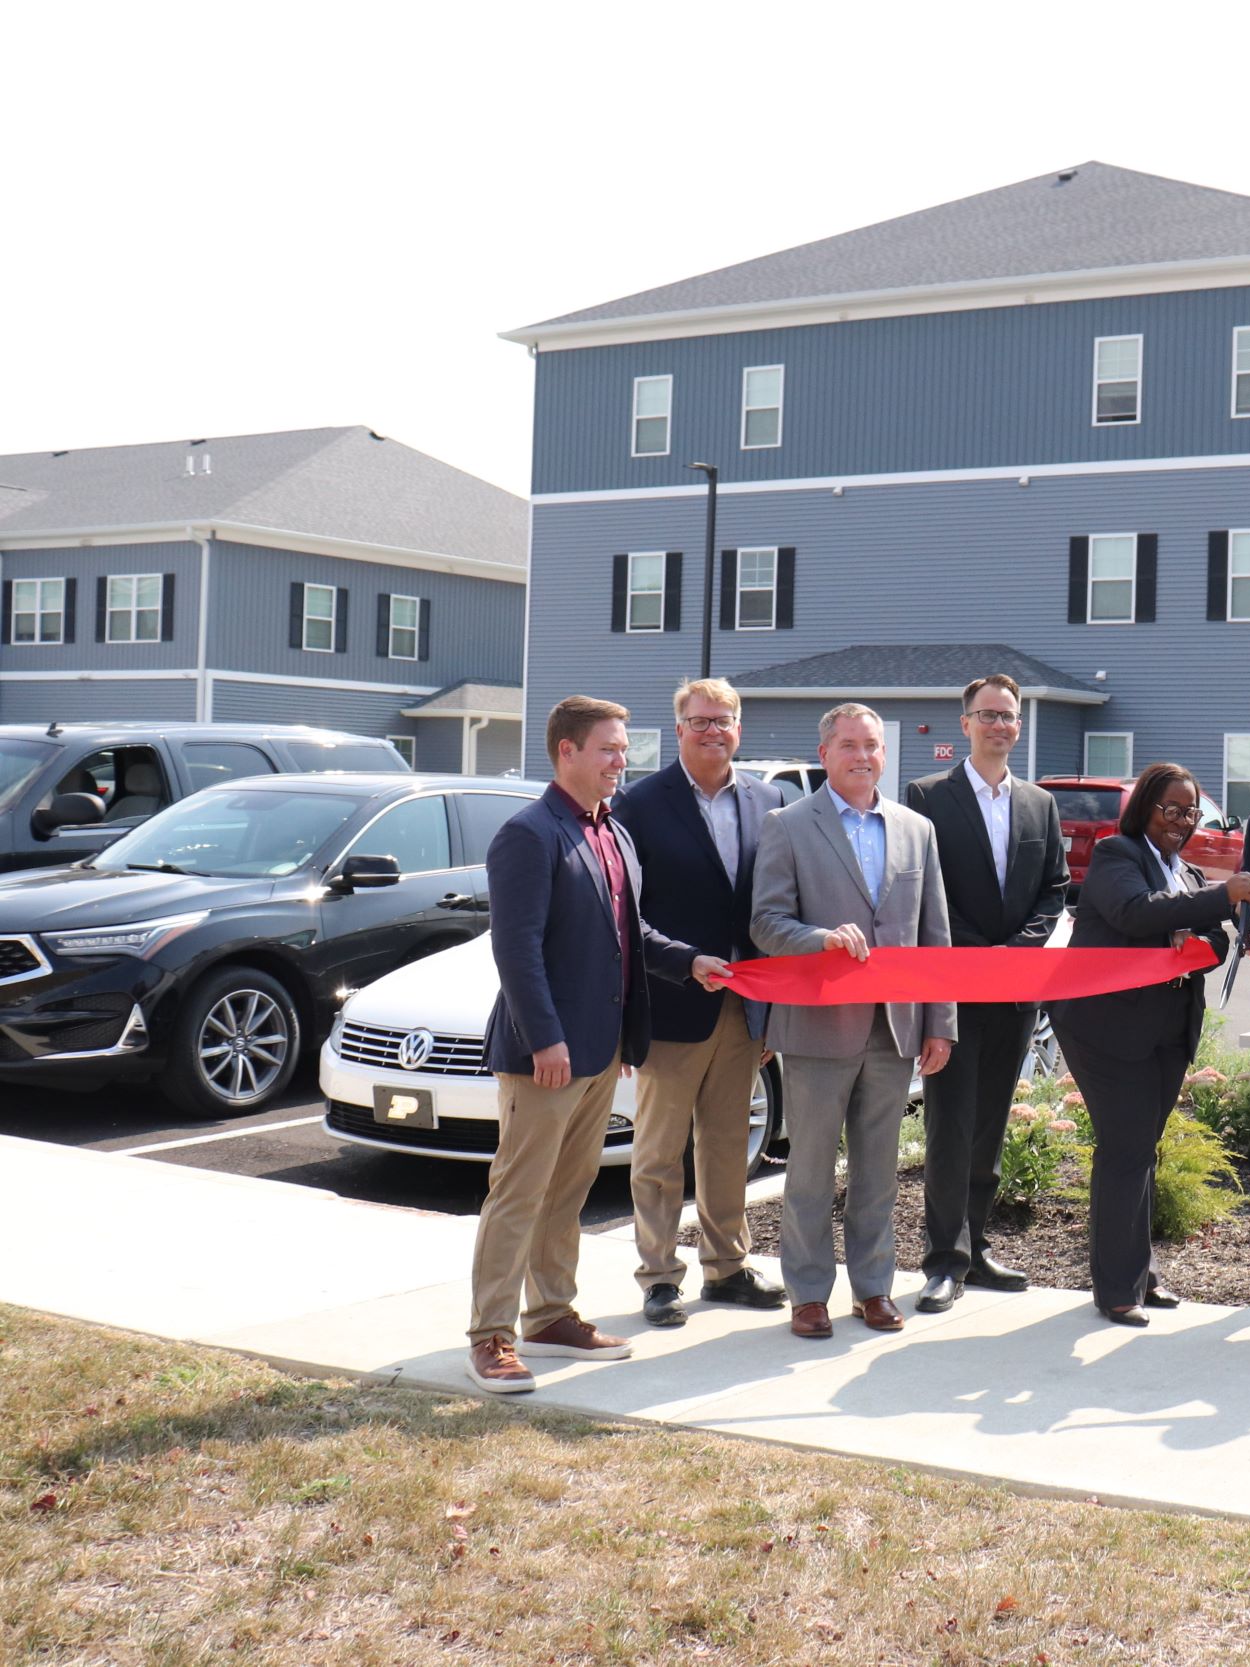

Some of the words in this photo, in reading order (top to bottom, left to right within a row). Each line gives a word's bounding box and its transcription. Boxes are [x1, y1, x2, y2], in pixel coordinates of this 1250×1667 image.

[935, 746, 953, 757] FDC
[399, 1029, 432, 1069] VW
[387, 1095, 419, 1119] P
